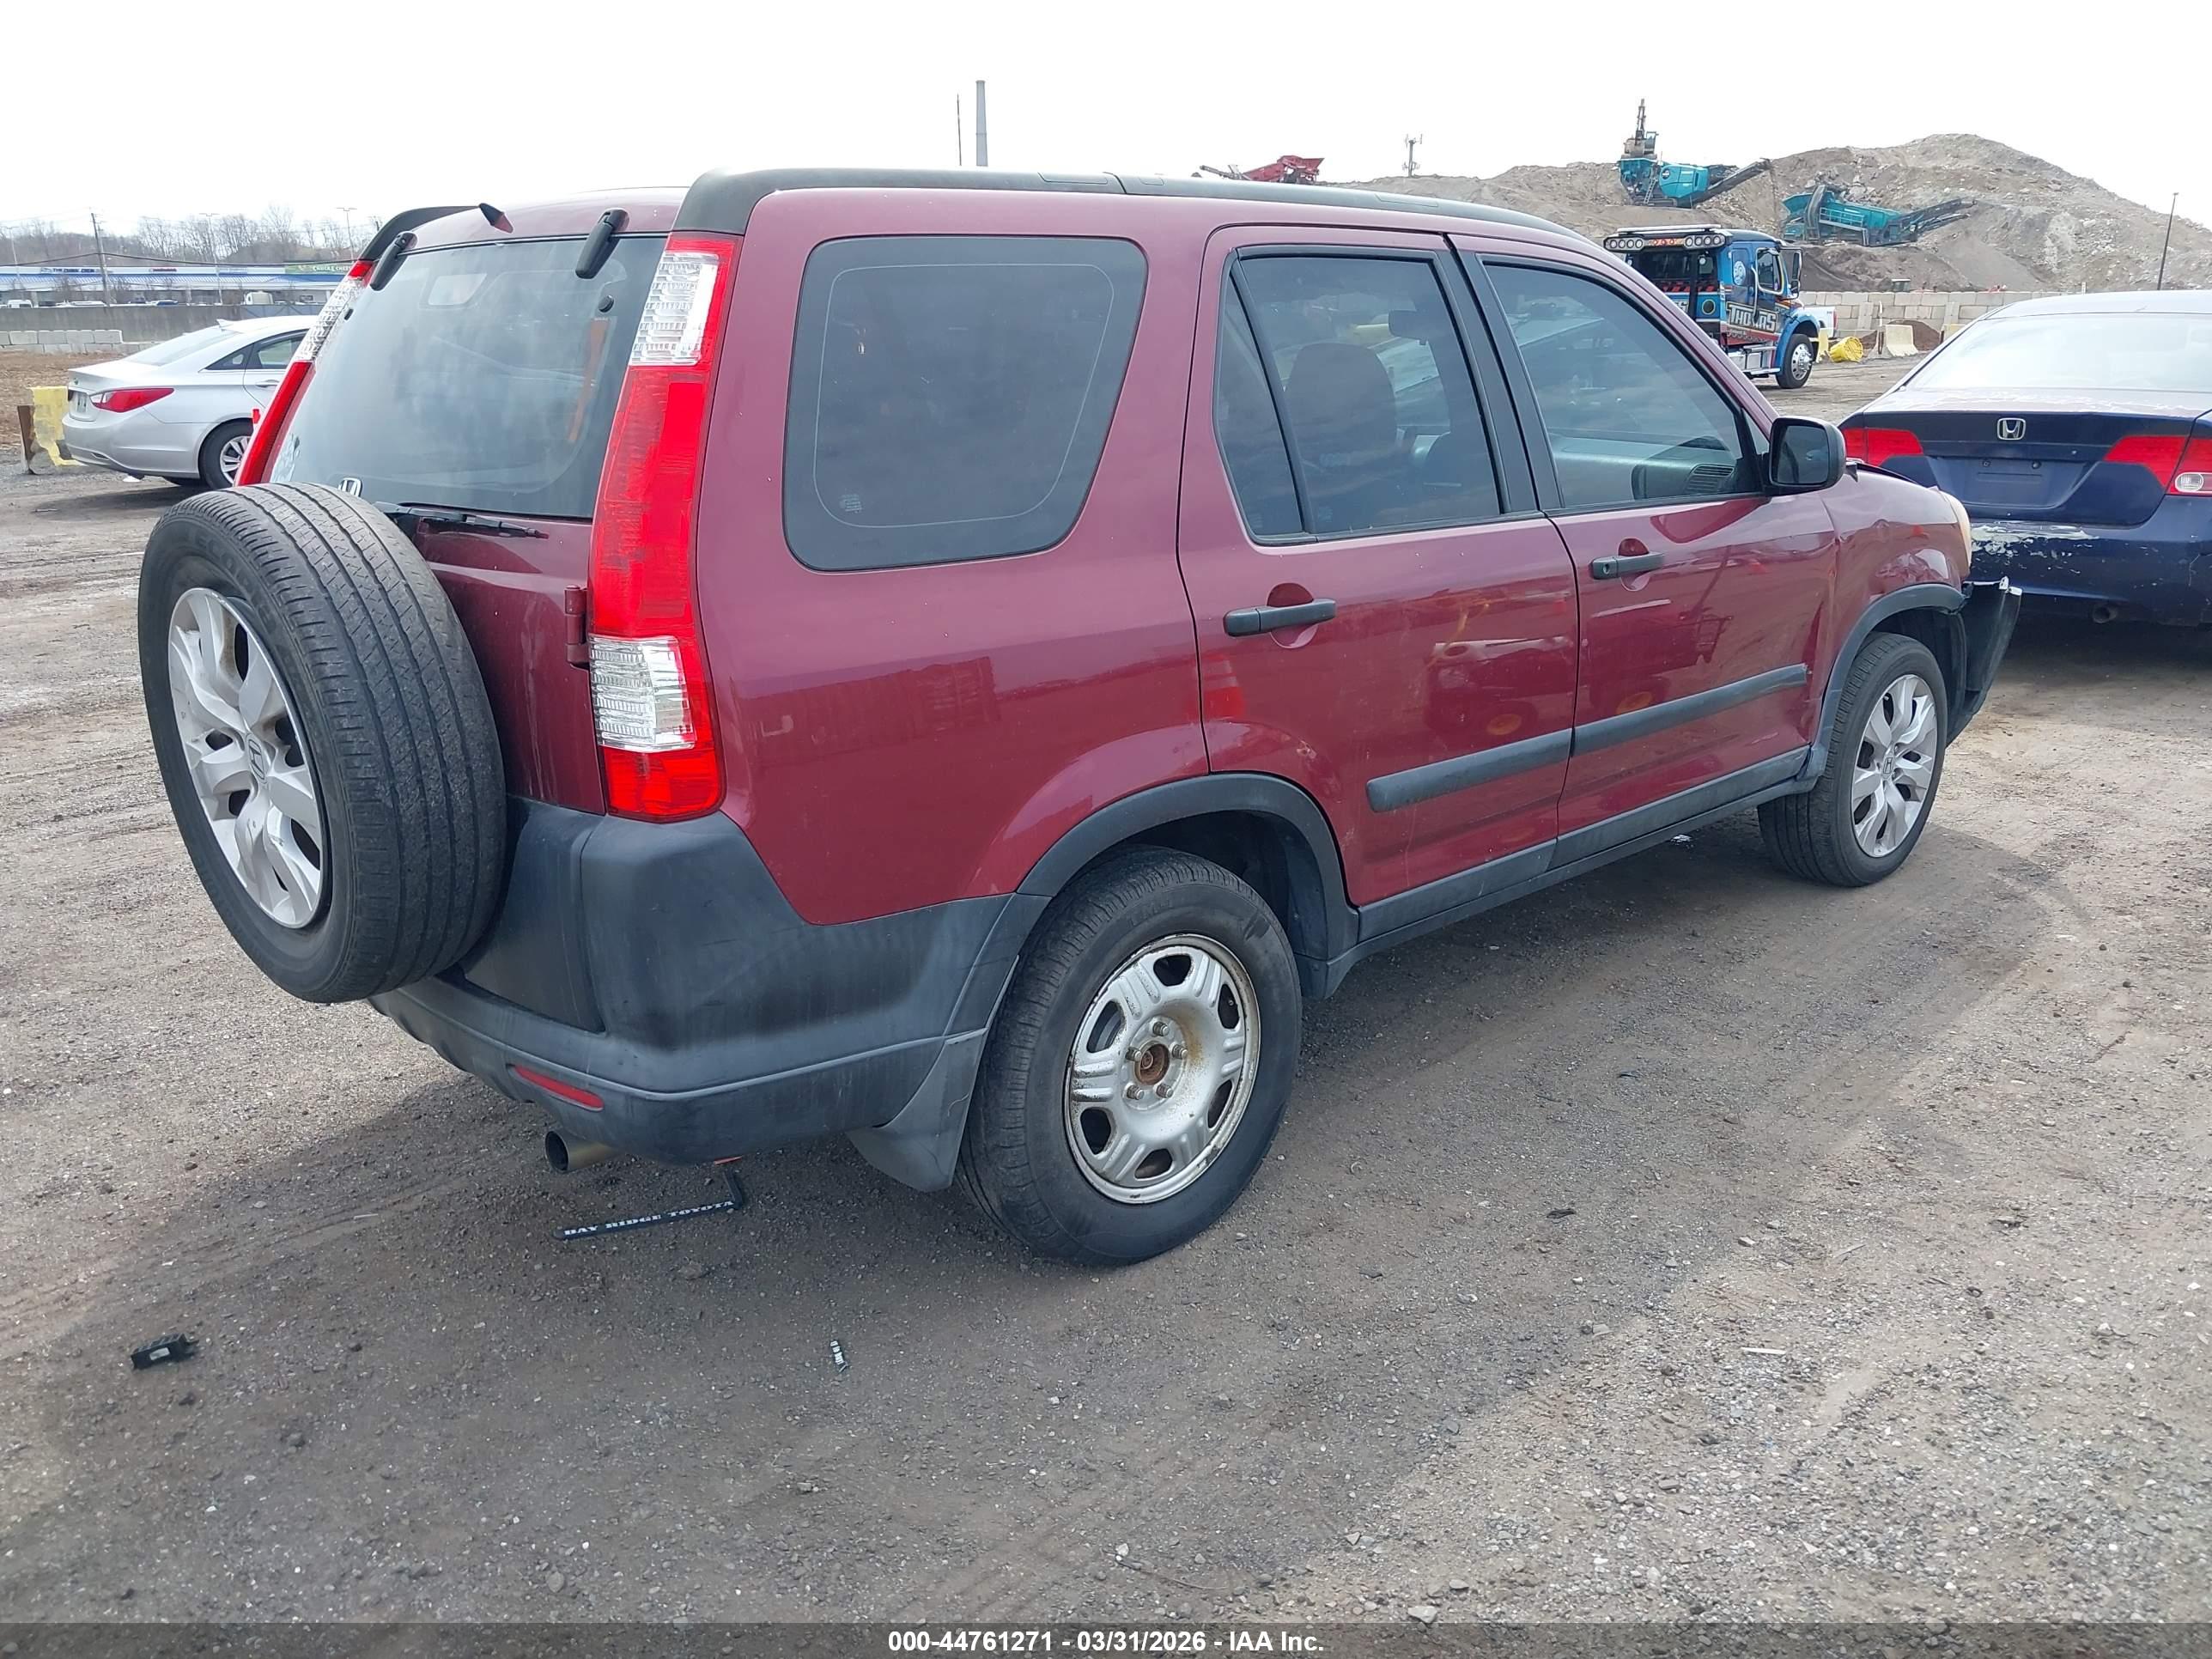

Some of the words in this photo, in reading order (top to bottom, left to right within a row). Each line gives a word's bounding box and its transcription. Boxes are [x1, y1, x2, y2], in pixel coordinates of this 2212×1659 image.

[564, 1225, 598, 1236] BAY
[605, 1214, 661, 1229] RIDGE
[667, 1200, 734, 1217] TOYOTA
